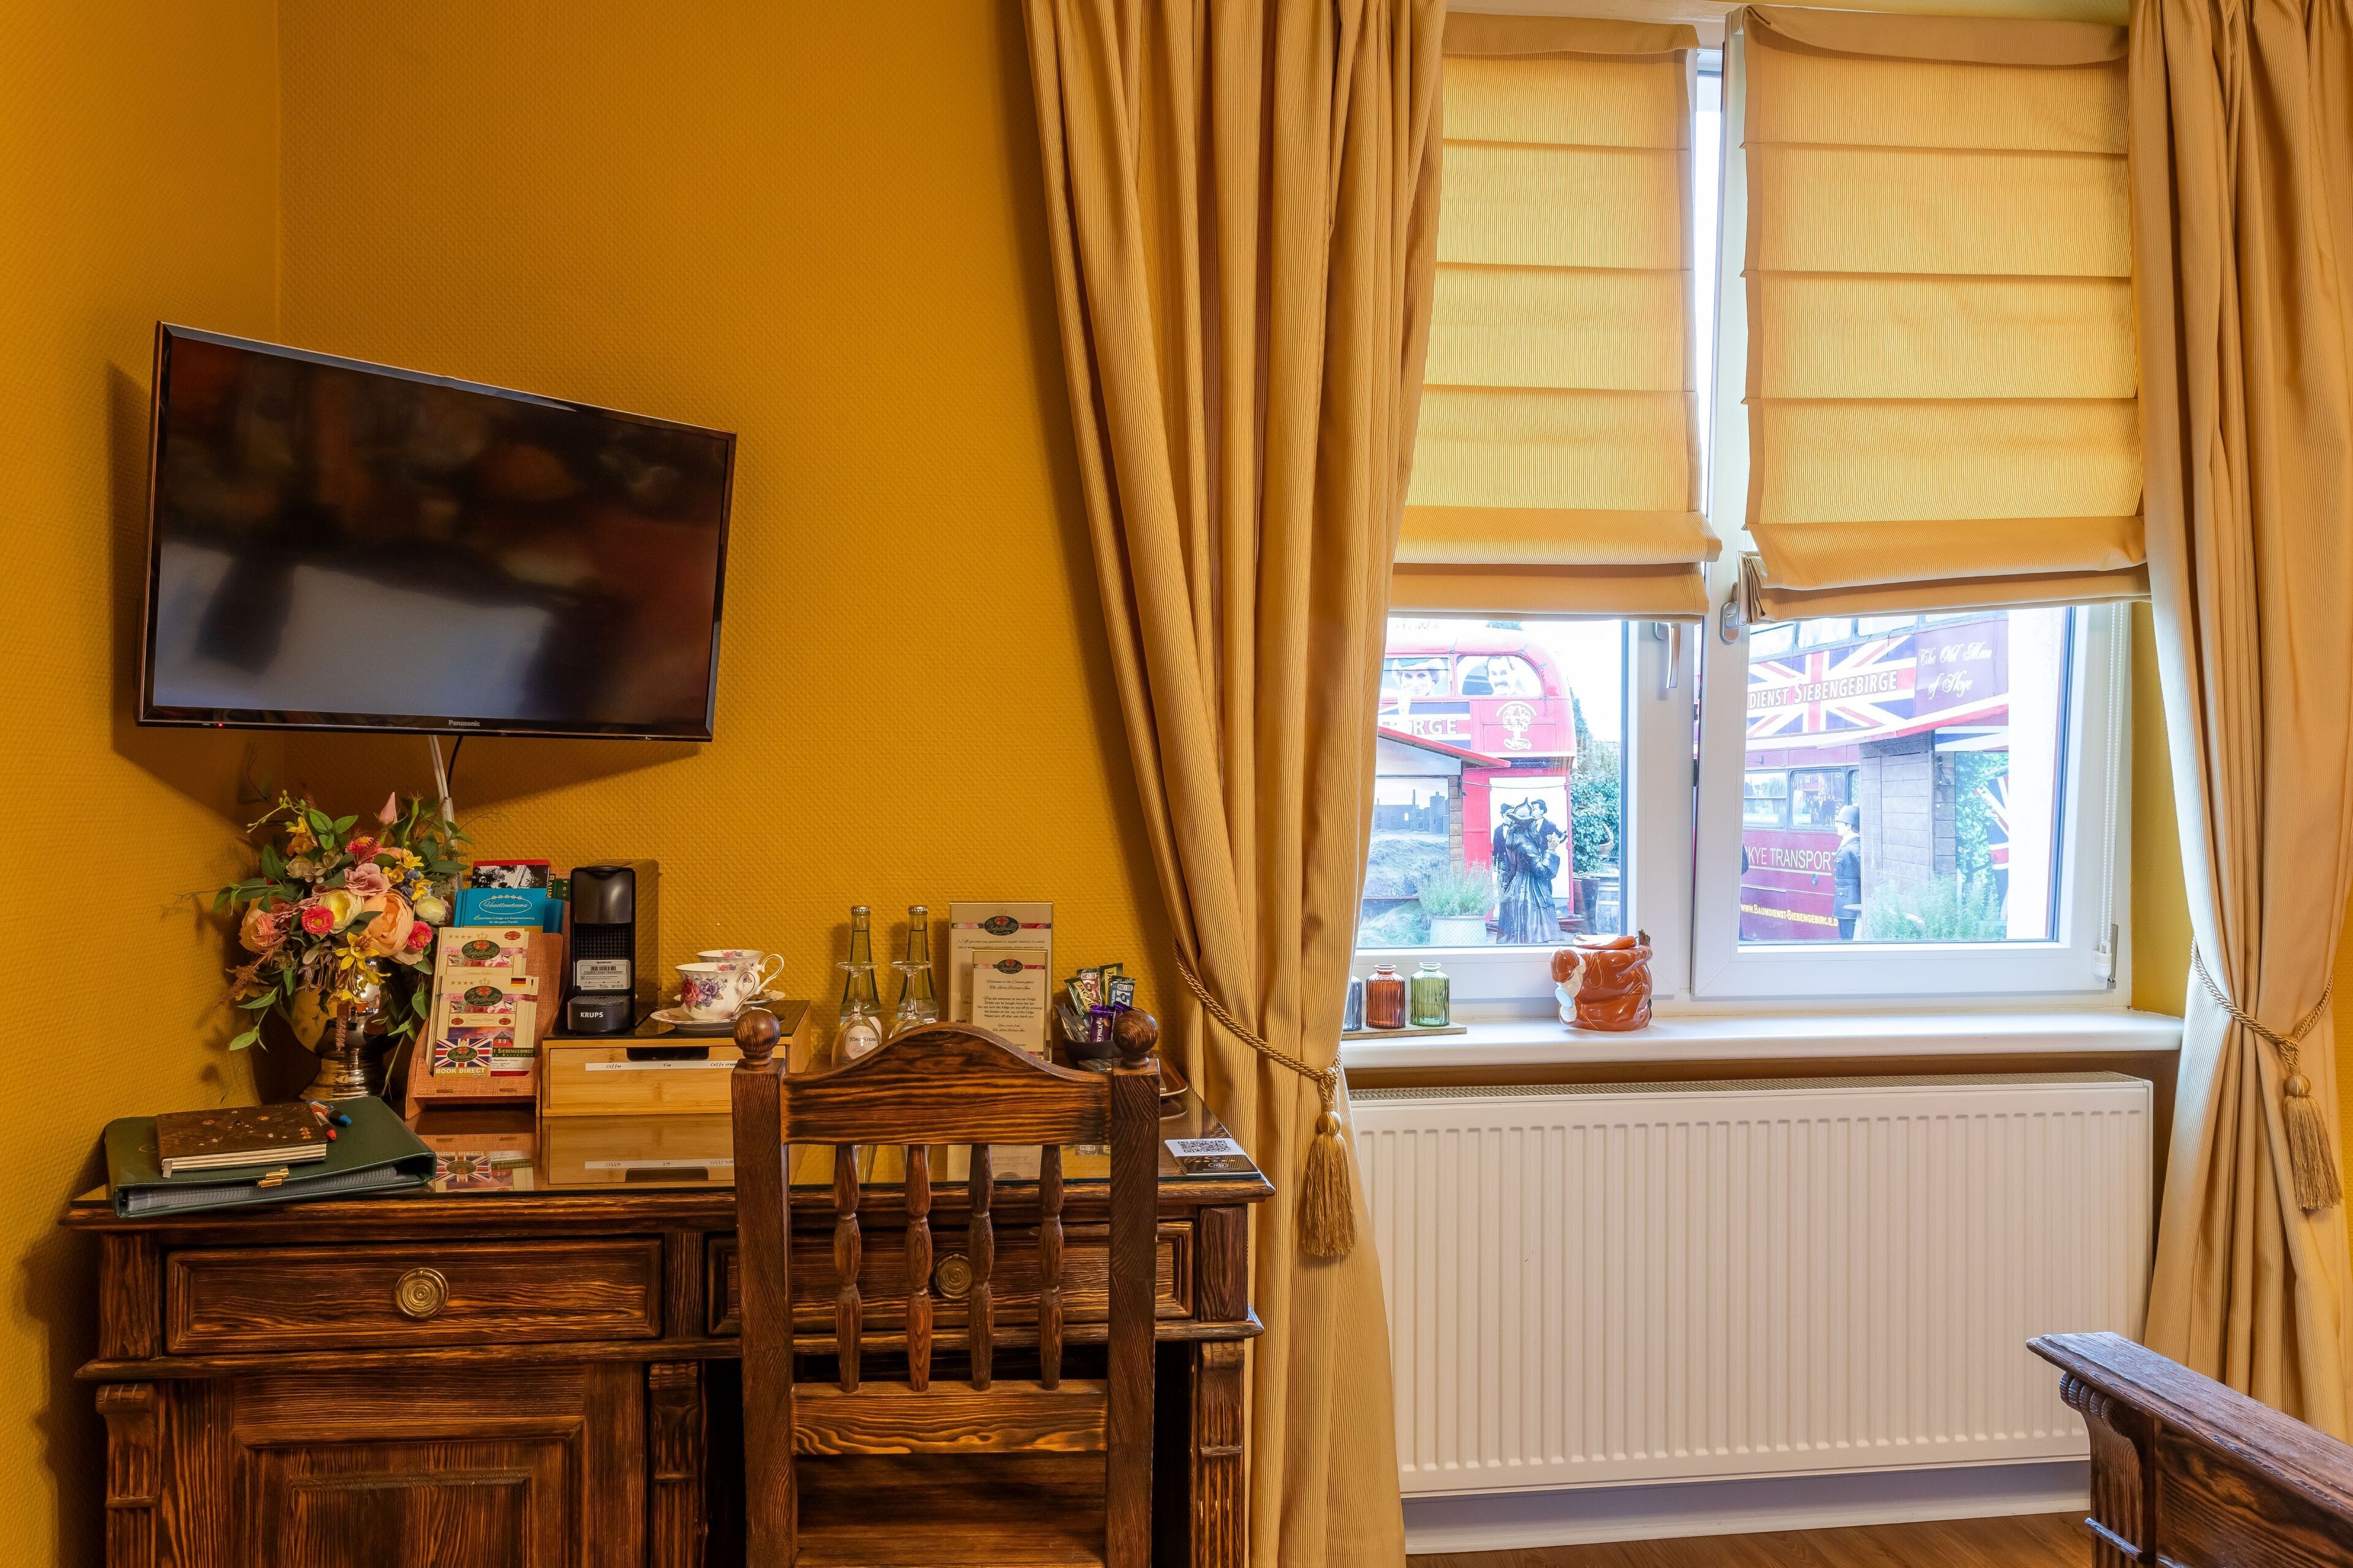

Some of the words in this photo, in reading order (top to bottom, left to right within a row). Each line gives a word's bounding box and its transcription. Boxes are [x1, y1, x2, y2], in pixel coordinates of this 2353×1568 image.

[1918, 647, 1936, 666] The
[1939, 643, 1965, 664] Old
[1962, 641, 1993, 661] Man
[1794, 670, 1898, 705] SIEBENGEBIRGE
[1928, 672, 1944, 700] of
[1942, 670, 1974, 698] Skye
